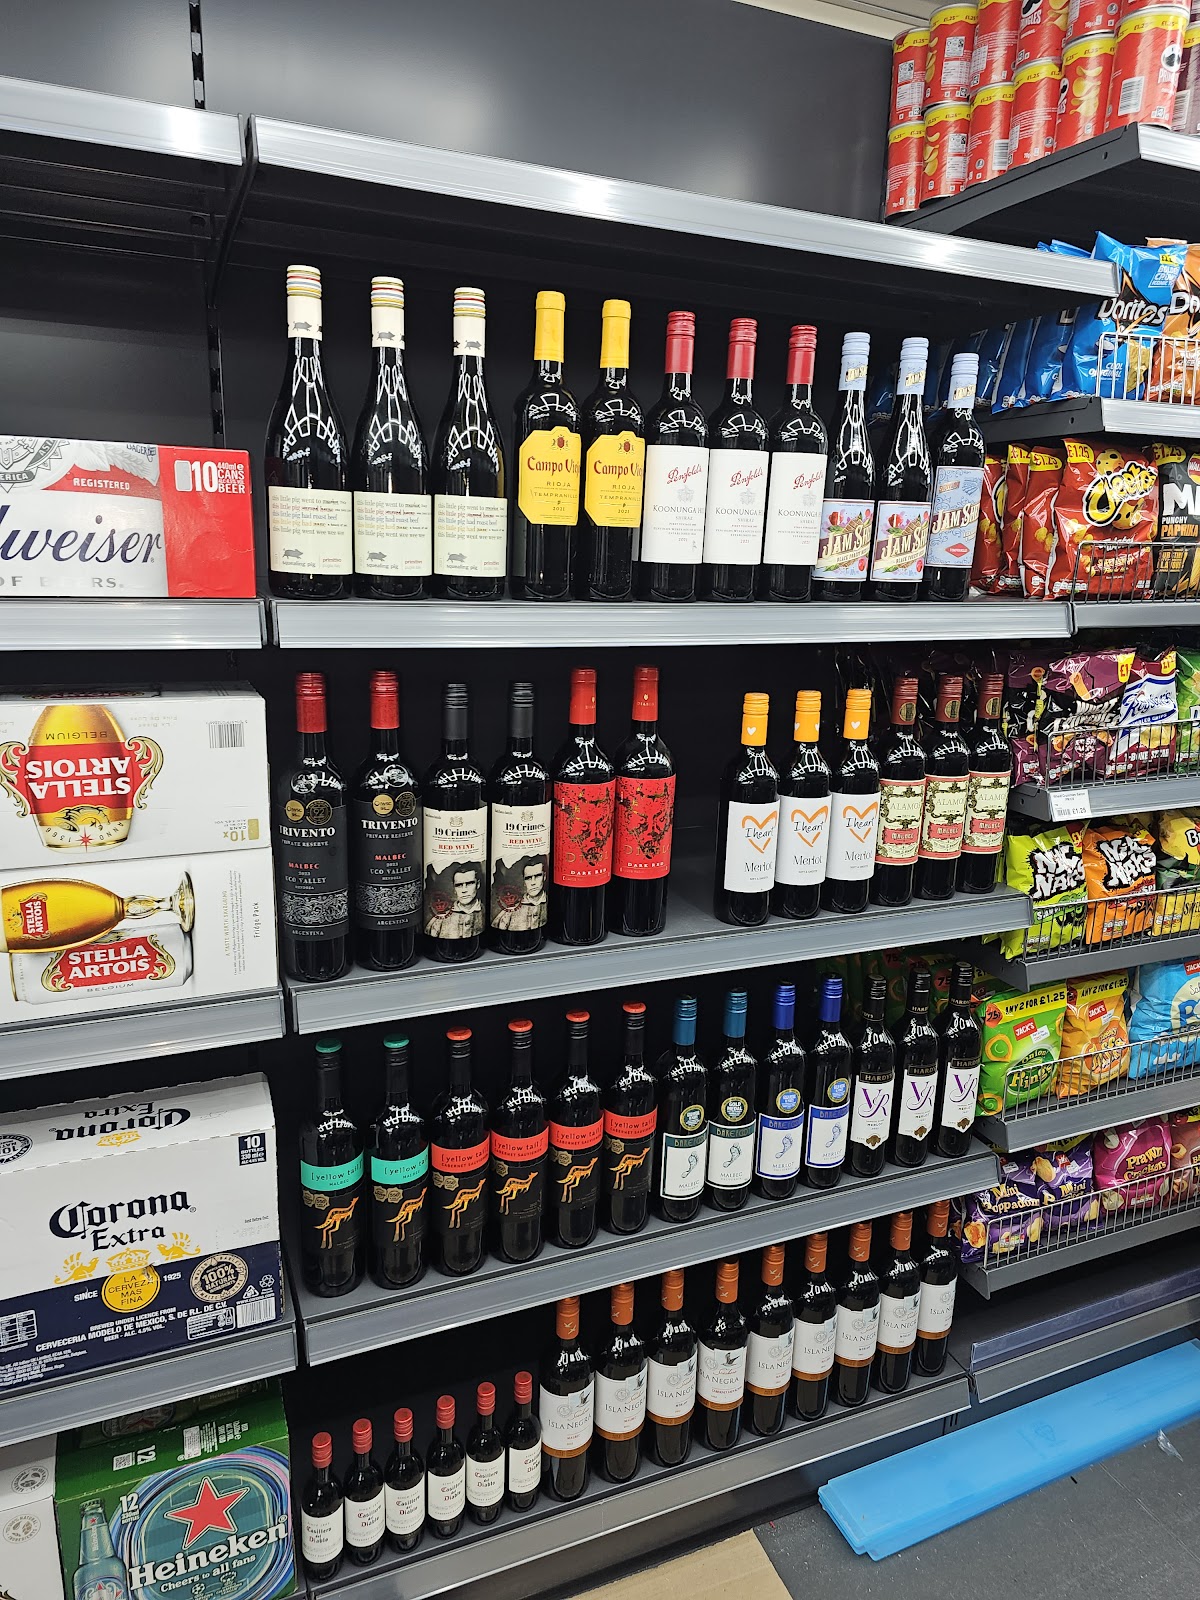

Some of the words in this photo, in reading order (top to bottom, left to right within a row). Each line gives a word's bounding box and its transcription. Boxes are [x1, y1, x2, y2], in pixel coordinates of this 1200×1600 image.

[1098, 299, 1168, 325] Doritos
[1068, 446, 1090, 458] £1.25
[1153, 445, 1182, 461] £1.25
[527, 456, 563, 476] Campo
[594, 460, 628, 479] Campo
[0, 472, 28, 480] ERICA
[192, 461, 218, 492] 10
[218, 470, 245, 480] CANS
[667, 465, 702, 484] Penfolds
[730, 467, 763, 487] Penfolds
[73, 478, 130, 490] REGISTERED
[218, 484, 246, 494] BEER
[653, 505, 697, 514] KOONUNGA
[715, 508, 758, 516] KOONUNGA
[932, 511, 962, 534] JAM
[1161, 524, 1199, 538] PAPRIKA
[822, 532, 853, 558] JAM
[881, 534, 912, 560] JAM
[45, 731, 108, 740] BELGIUM
[26, 757, 131, 779] ARTOIS
[28, 778, 131, 799] STELLA
[890, 802, 920, 811] ALAMO
[361, 817, 418, 830] TRIVENTO
[516, 823, 545, 831] Crimes
[801, 820, 824, 833] heart
[853, 817, 875, 829] heart
[279, 825, 335, 837] TRIVENTO
[445, 828, 478, 837] Crimes
[752, 826, 774, 840] heart
[375, 853, 406, 861] MALBEC
[793, 855, 822, 866] Merlot
[844, 850, 872, 861] Merlot
[744, 862, 772, 873] Merlot
[252, 902, 260, 917] Pack
[26, 901, 34, 934] STELLA
[34, 901, 44, 933] ARTOIS
[253, 919, 261, 938] Fridge
[68, 945, 149, 965] STELLA
[69, 958, 151, 980] ARTOIS
[86, 982, 134, 992] BELGIUM
[1109, 978, 1128, 989] £1.25
[1025, 998, 1038, 1008] FOR
[1040, 992, 1065, 1004] £1.25
[1089, 1005, 1105, 1017] JACK'S
[1015, 1022, 1035, 1036] JACK'S
[54, 1108, 191, 1141] Corona
[244, 1136, 260, 1148] 10
[1126, 1147, 1163, 1169] Prawn
[1124, 1161, 1166, 1180] Crackers
[991, 1184, 1019, 1199] Mini
[1060, 1180, 1087, 1197] Mini
[49, 1190, 191, 1239] Corona
[91, 1226, 166, 1251] Extra
[124, 1275, 137, 1283] LA
[163, 1272, 181, 1282] 1925
[202, 1264, 235, 1284] 100%
[108, 1277, 154, 1294] CERVEZA
[205, 1274, 236, 1290] NATURAL
[74, 1290, 98, 1302] SINCE
[121, 1289, 142, 1298] MAS
[121, 1296, 143, 1305] FINA
[115, 1317, 134, 1325] UNDER
[136, 1311, 159, 1320] LICENCE
[160, 1307, 176, 1315] FROM
[35, 1334, 87, 1352] CERVECERIA
[88, 1327, 122, 1340] MODELO
[135, 1316, 167, 1330] MEXICO,
[177, 1310, 188, 1319] DE
[203, 1304, 214, 1313] DE
[883, 1319, 899, 1329] ISLA
[842, 1333, 858, 1342] ISLA
[804, 1347, 820, 1355] ISLA
[758, 1361, 774, 1370] ISLA
[713, 1376, 739, 1385] NEGRA
[657, 1389, 674, 1398] ISLA
[605, 1404, 623, 1413] ISLA
[548, 1420, 565, 1430] ISLA
[475, 1470, 498, 1478] Casillero
[441, 1480, 463, 1492] Casillero
[396, 1496, 420, 1506] Casillero
[444, 1491, 461, 1501] Diablo
[120, 1493, 139, 1513] 12
[357, 1505, 381, 1518] Casillero
[400, 1507, 418, 1515] Diablo
[361, 1517, 379, 1527] Diablo
[306, 1525, 332, 1534] Casillero
[129, 1522, 288, 1590] Heineken
[160, 1575, 200, 1592] Cheers
[212, 1562, 230, 1577] all
[232, 1554, 256, 1569] fans
